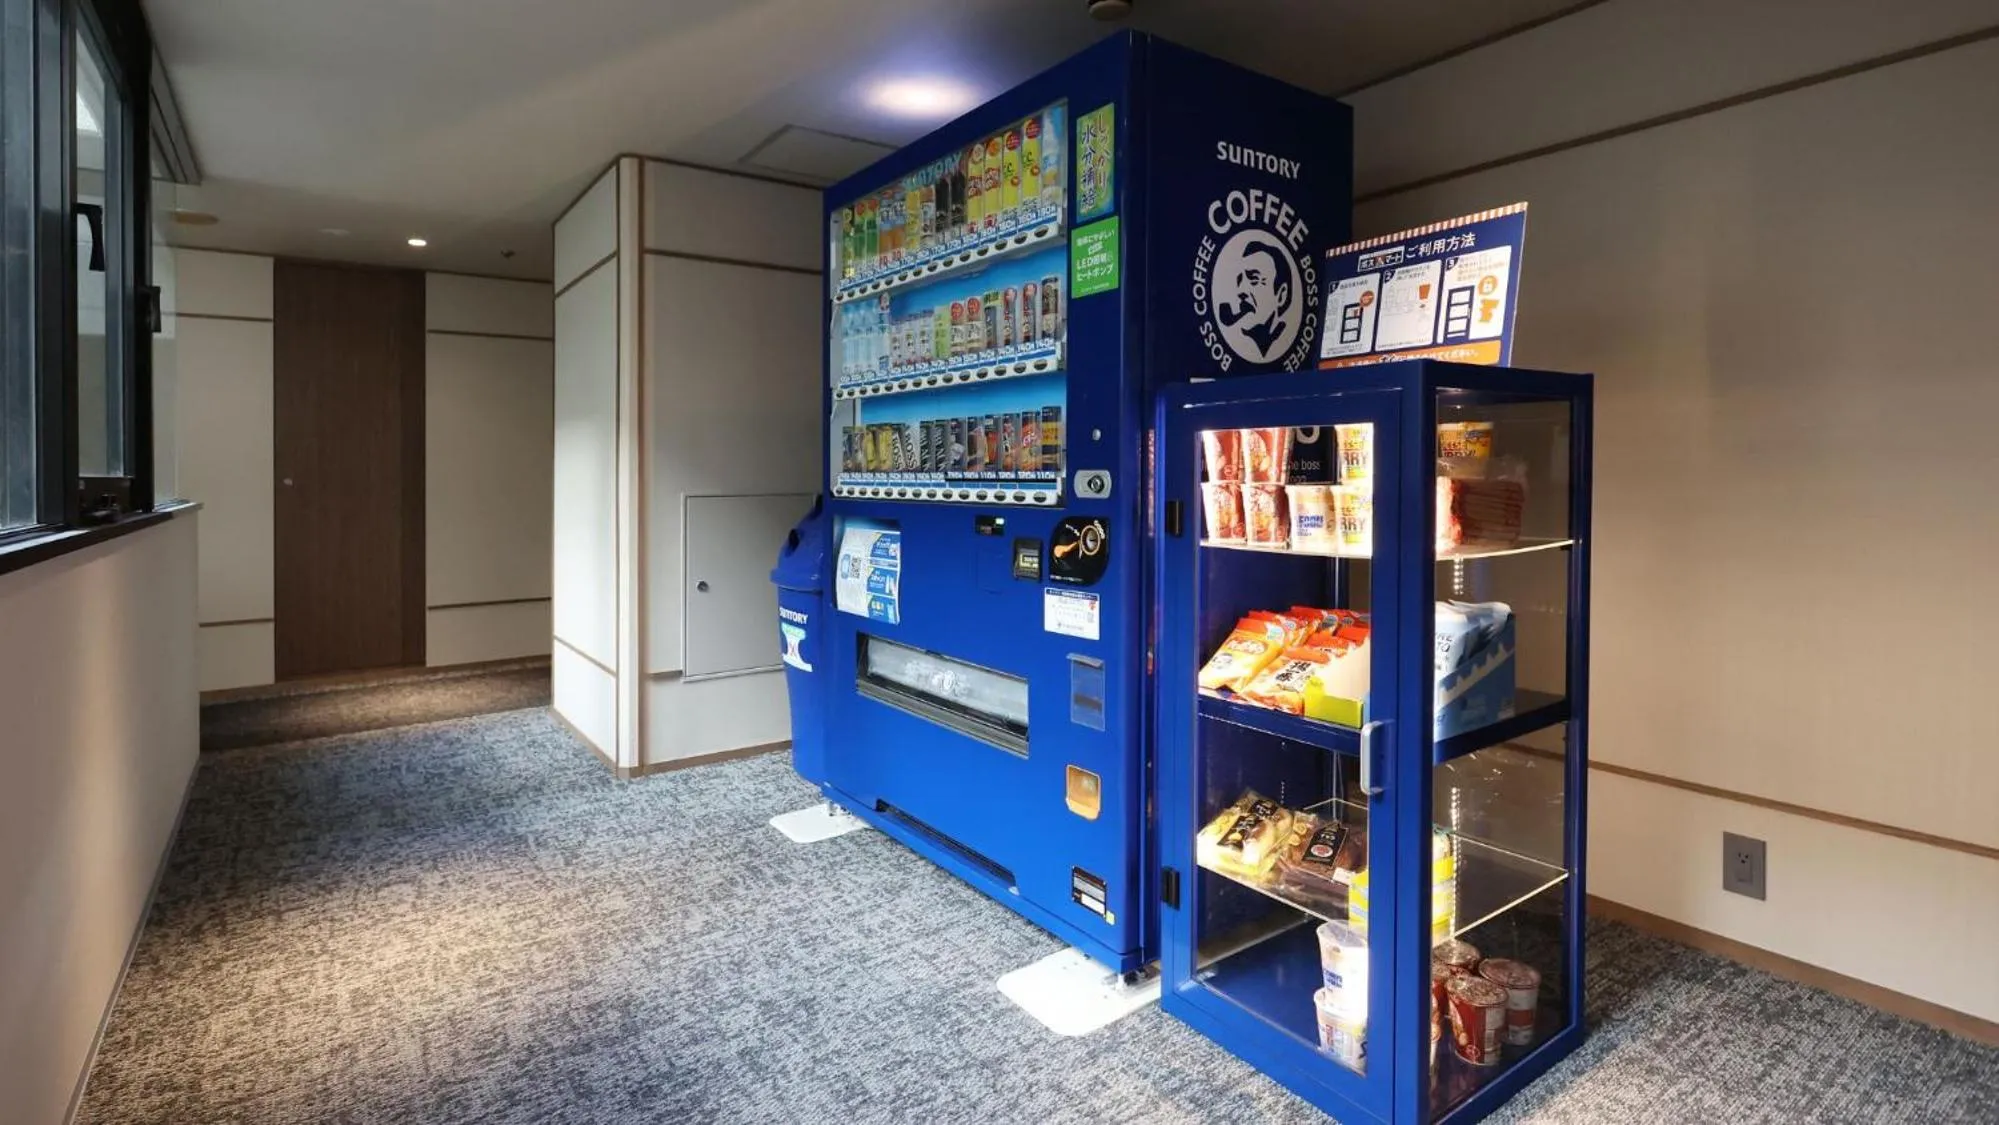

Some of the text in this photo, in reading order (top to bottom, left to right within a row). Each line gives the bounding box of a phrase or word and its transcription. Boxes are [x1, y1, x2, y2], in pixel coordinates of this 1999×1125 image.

[1216, 140, 1301, 180] SUNTORY
[1208, 188, 1309, 251] COFFEE
[1406, 232, 1475, 258] ご利用方法
[1193, 235, 1216, 315] COFFEE
[1300, 255, 1319, 306] BOSS
